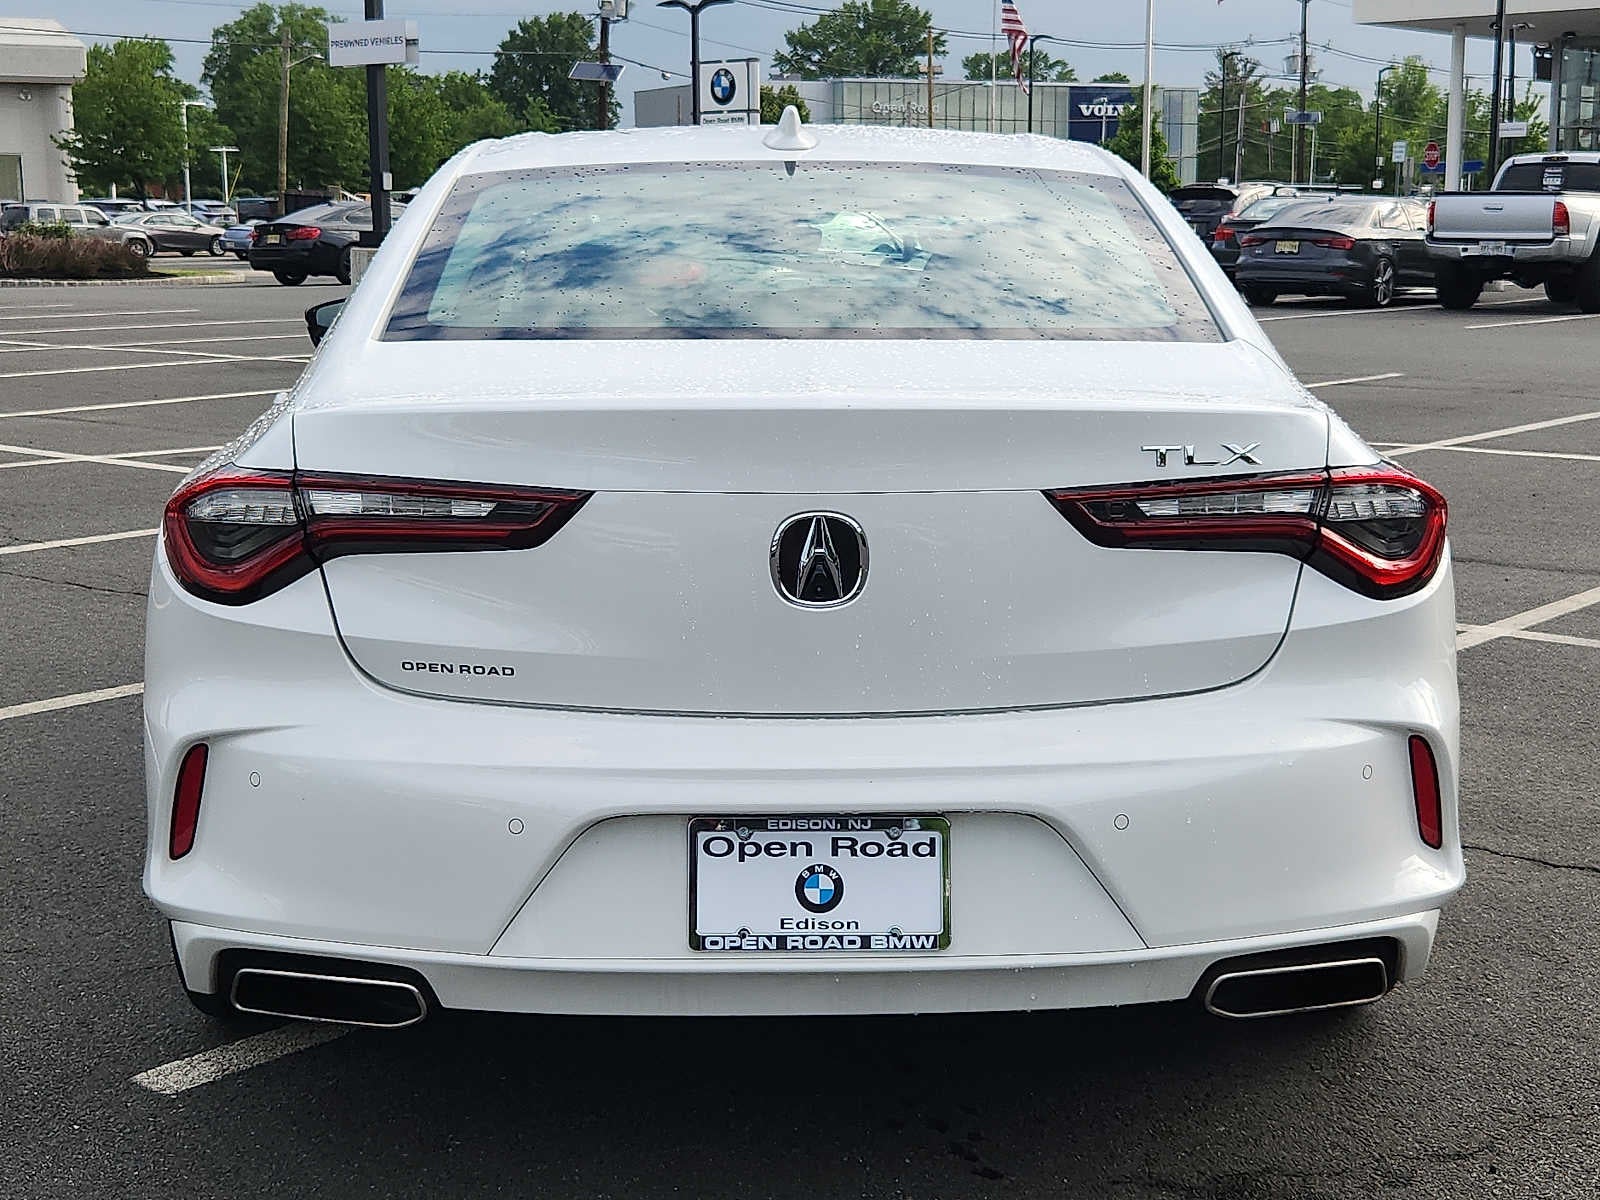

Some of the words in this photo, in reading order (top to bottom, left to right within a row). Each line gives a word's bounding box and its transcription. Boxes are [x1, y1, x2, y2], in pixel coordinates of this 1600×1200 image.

[872, 101, 906, 116] Open
[1078, 104, 1138, 117] VOLV
[1140, 441, 1263, 468] TLX
[401, 661, 454, 674] OPEN
[459, 664, 515, 677] ROAD
[766, 818, 841, 831] EDISON,
[847, 818, 872, 830] NJ
[702, 836, 813, 862] Open
[830, 836, 937, 858] Road
[801, 865, 840, 880] BMW
[780, 917, 860, 930] Edison
[704, 935, 780, 950] OPEN
[786, 935, 862, 950] ROAD
[870, 935, 935, 950] BMW
